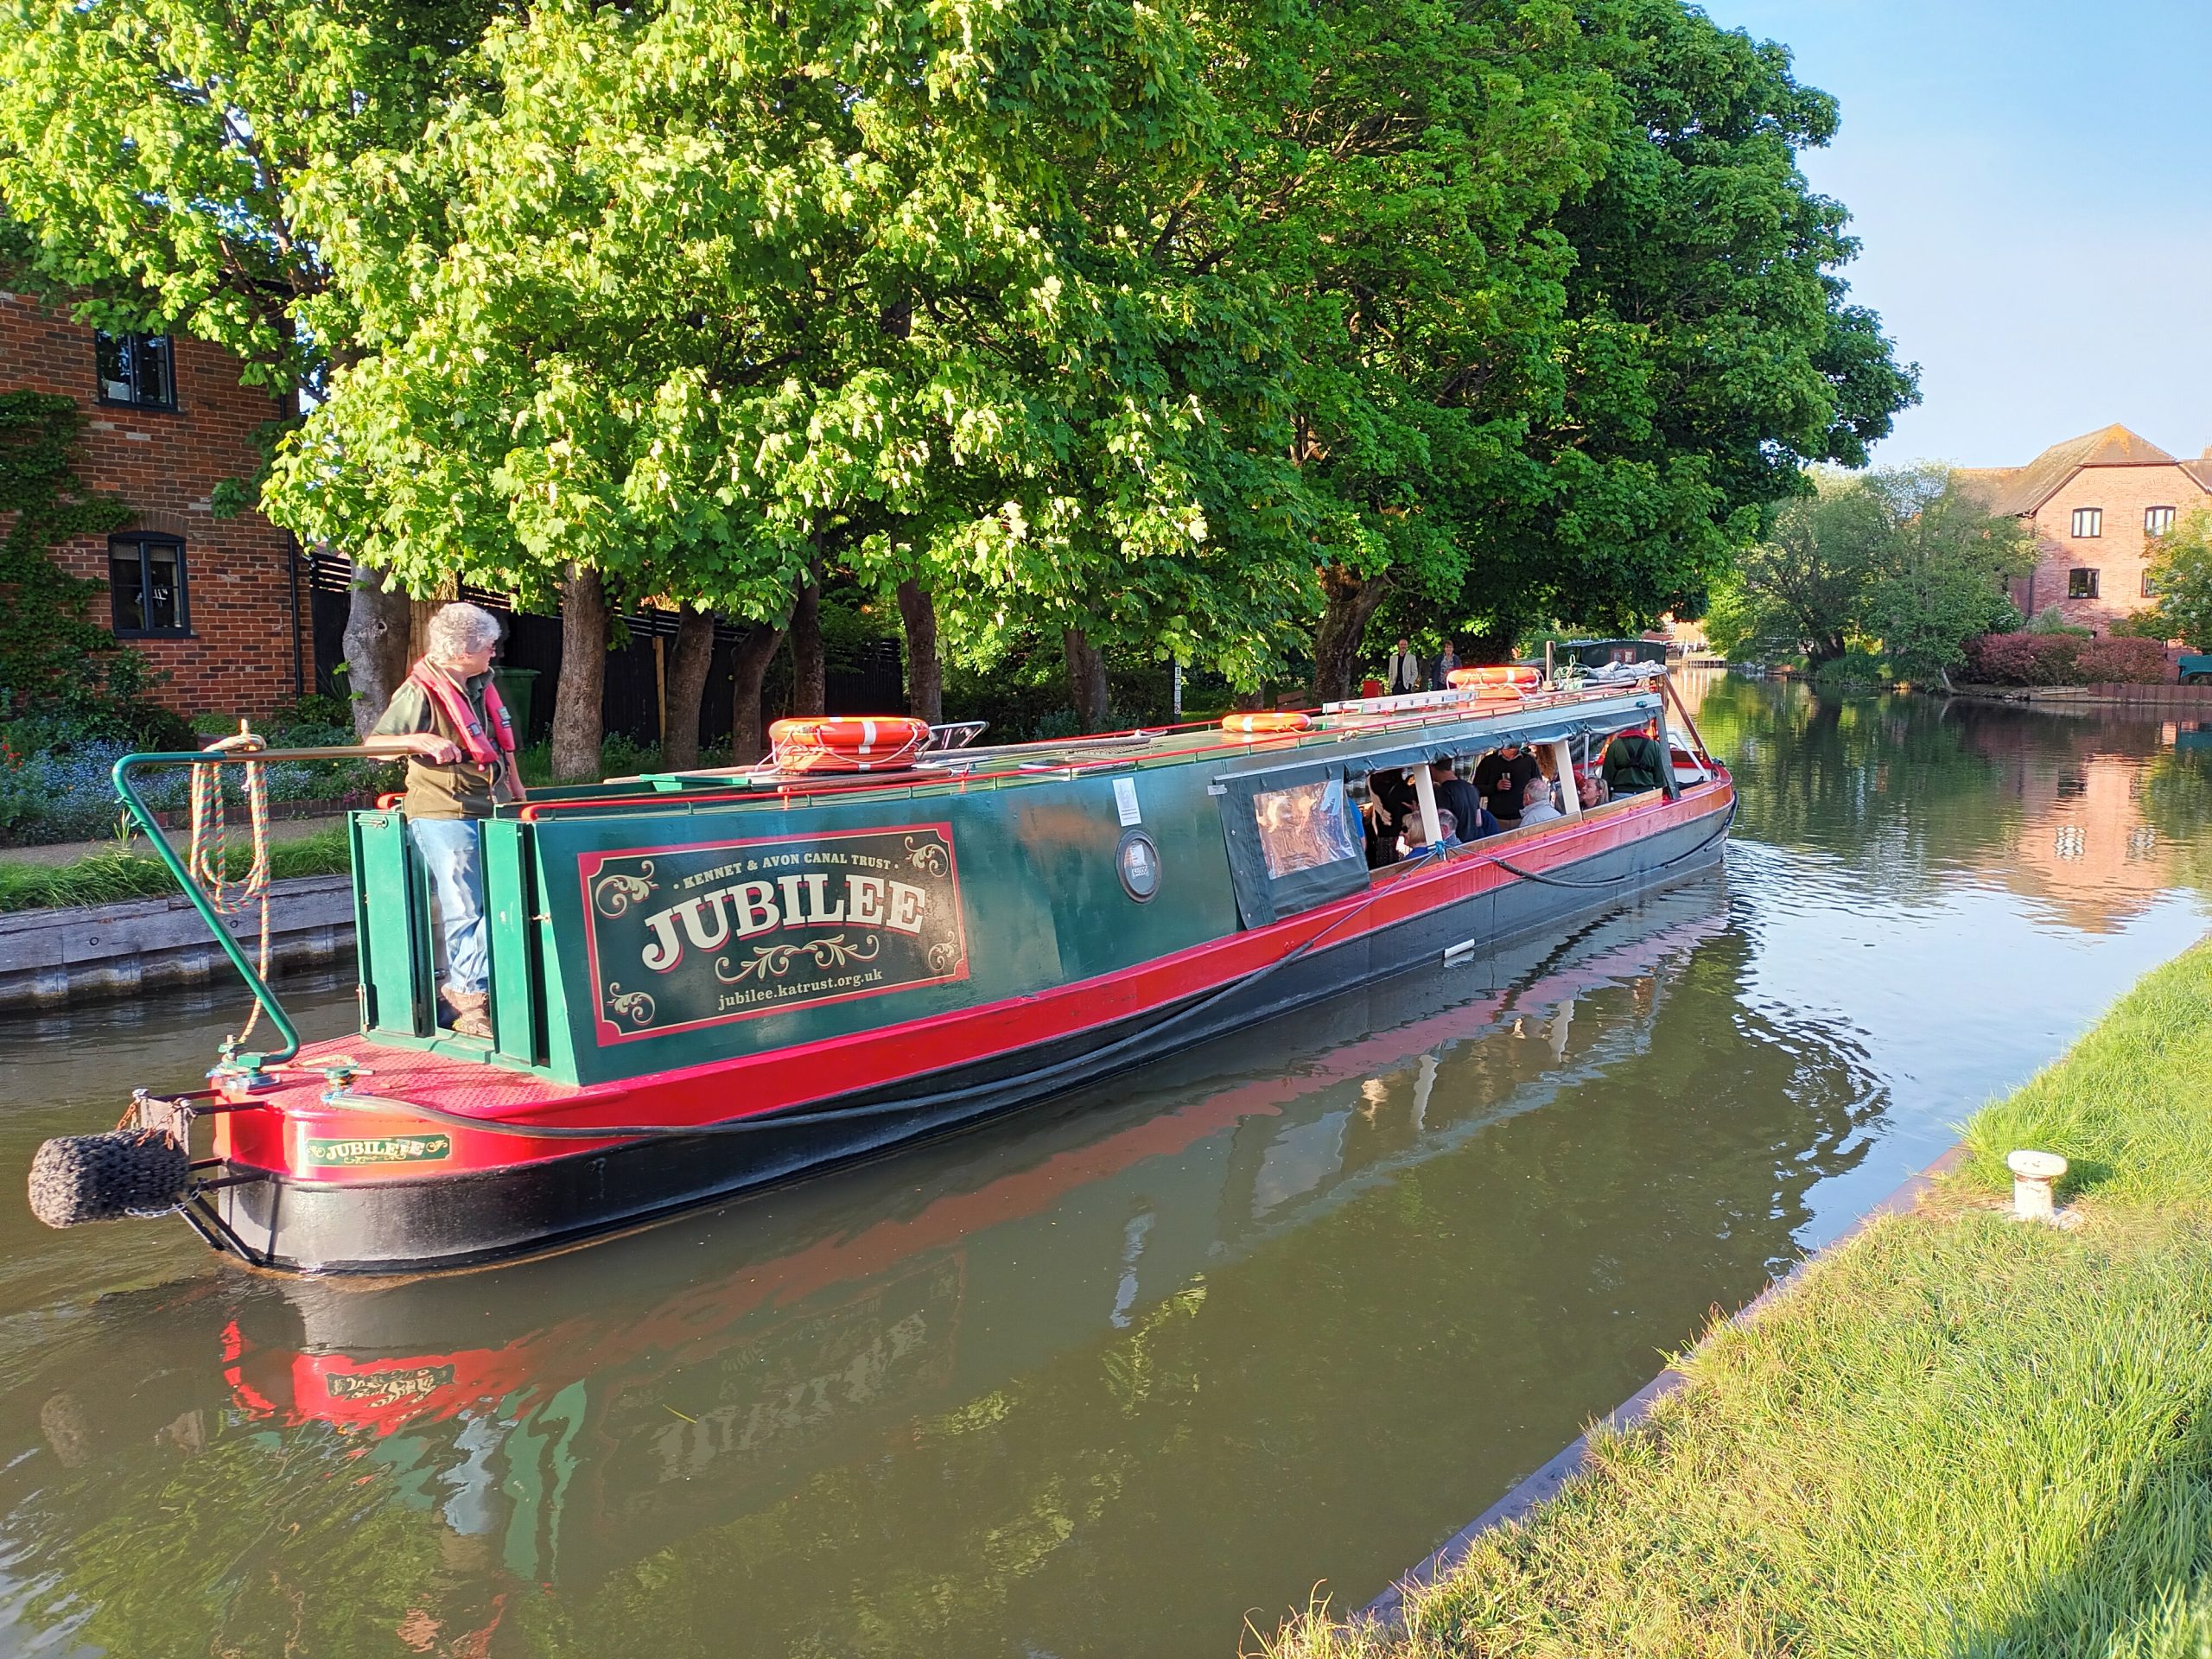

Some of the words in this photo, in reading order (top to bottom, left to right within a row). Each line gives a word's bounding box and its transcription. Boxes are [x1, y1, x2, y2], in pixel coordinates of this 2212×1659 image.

[683, 862, 742, 889] KENNET
[747, 860, 759, 871] &
[762, 854, 800, 868] AVON
[804, 852, 848, 864] CANAL
[851, 854, 891, 870] TRUST
[641, 873, 925, 972] JUBILEE
[718, 969, 883, 1010] jubilee.katrust.org.uk
